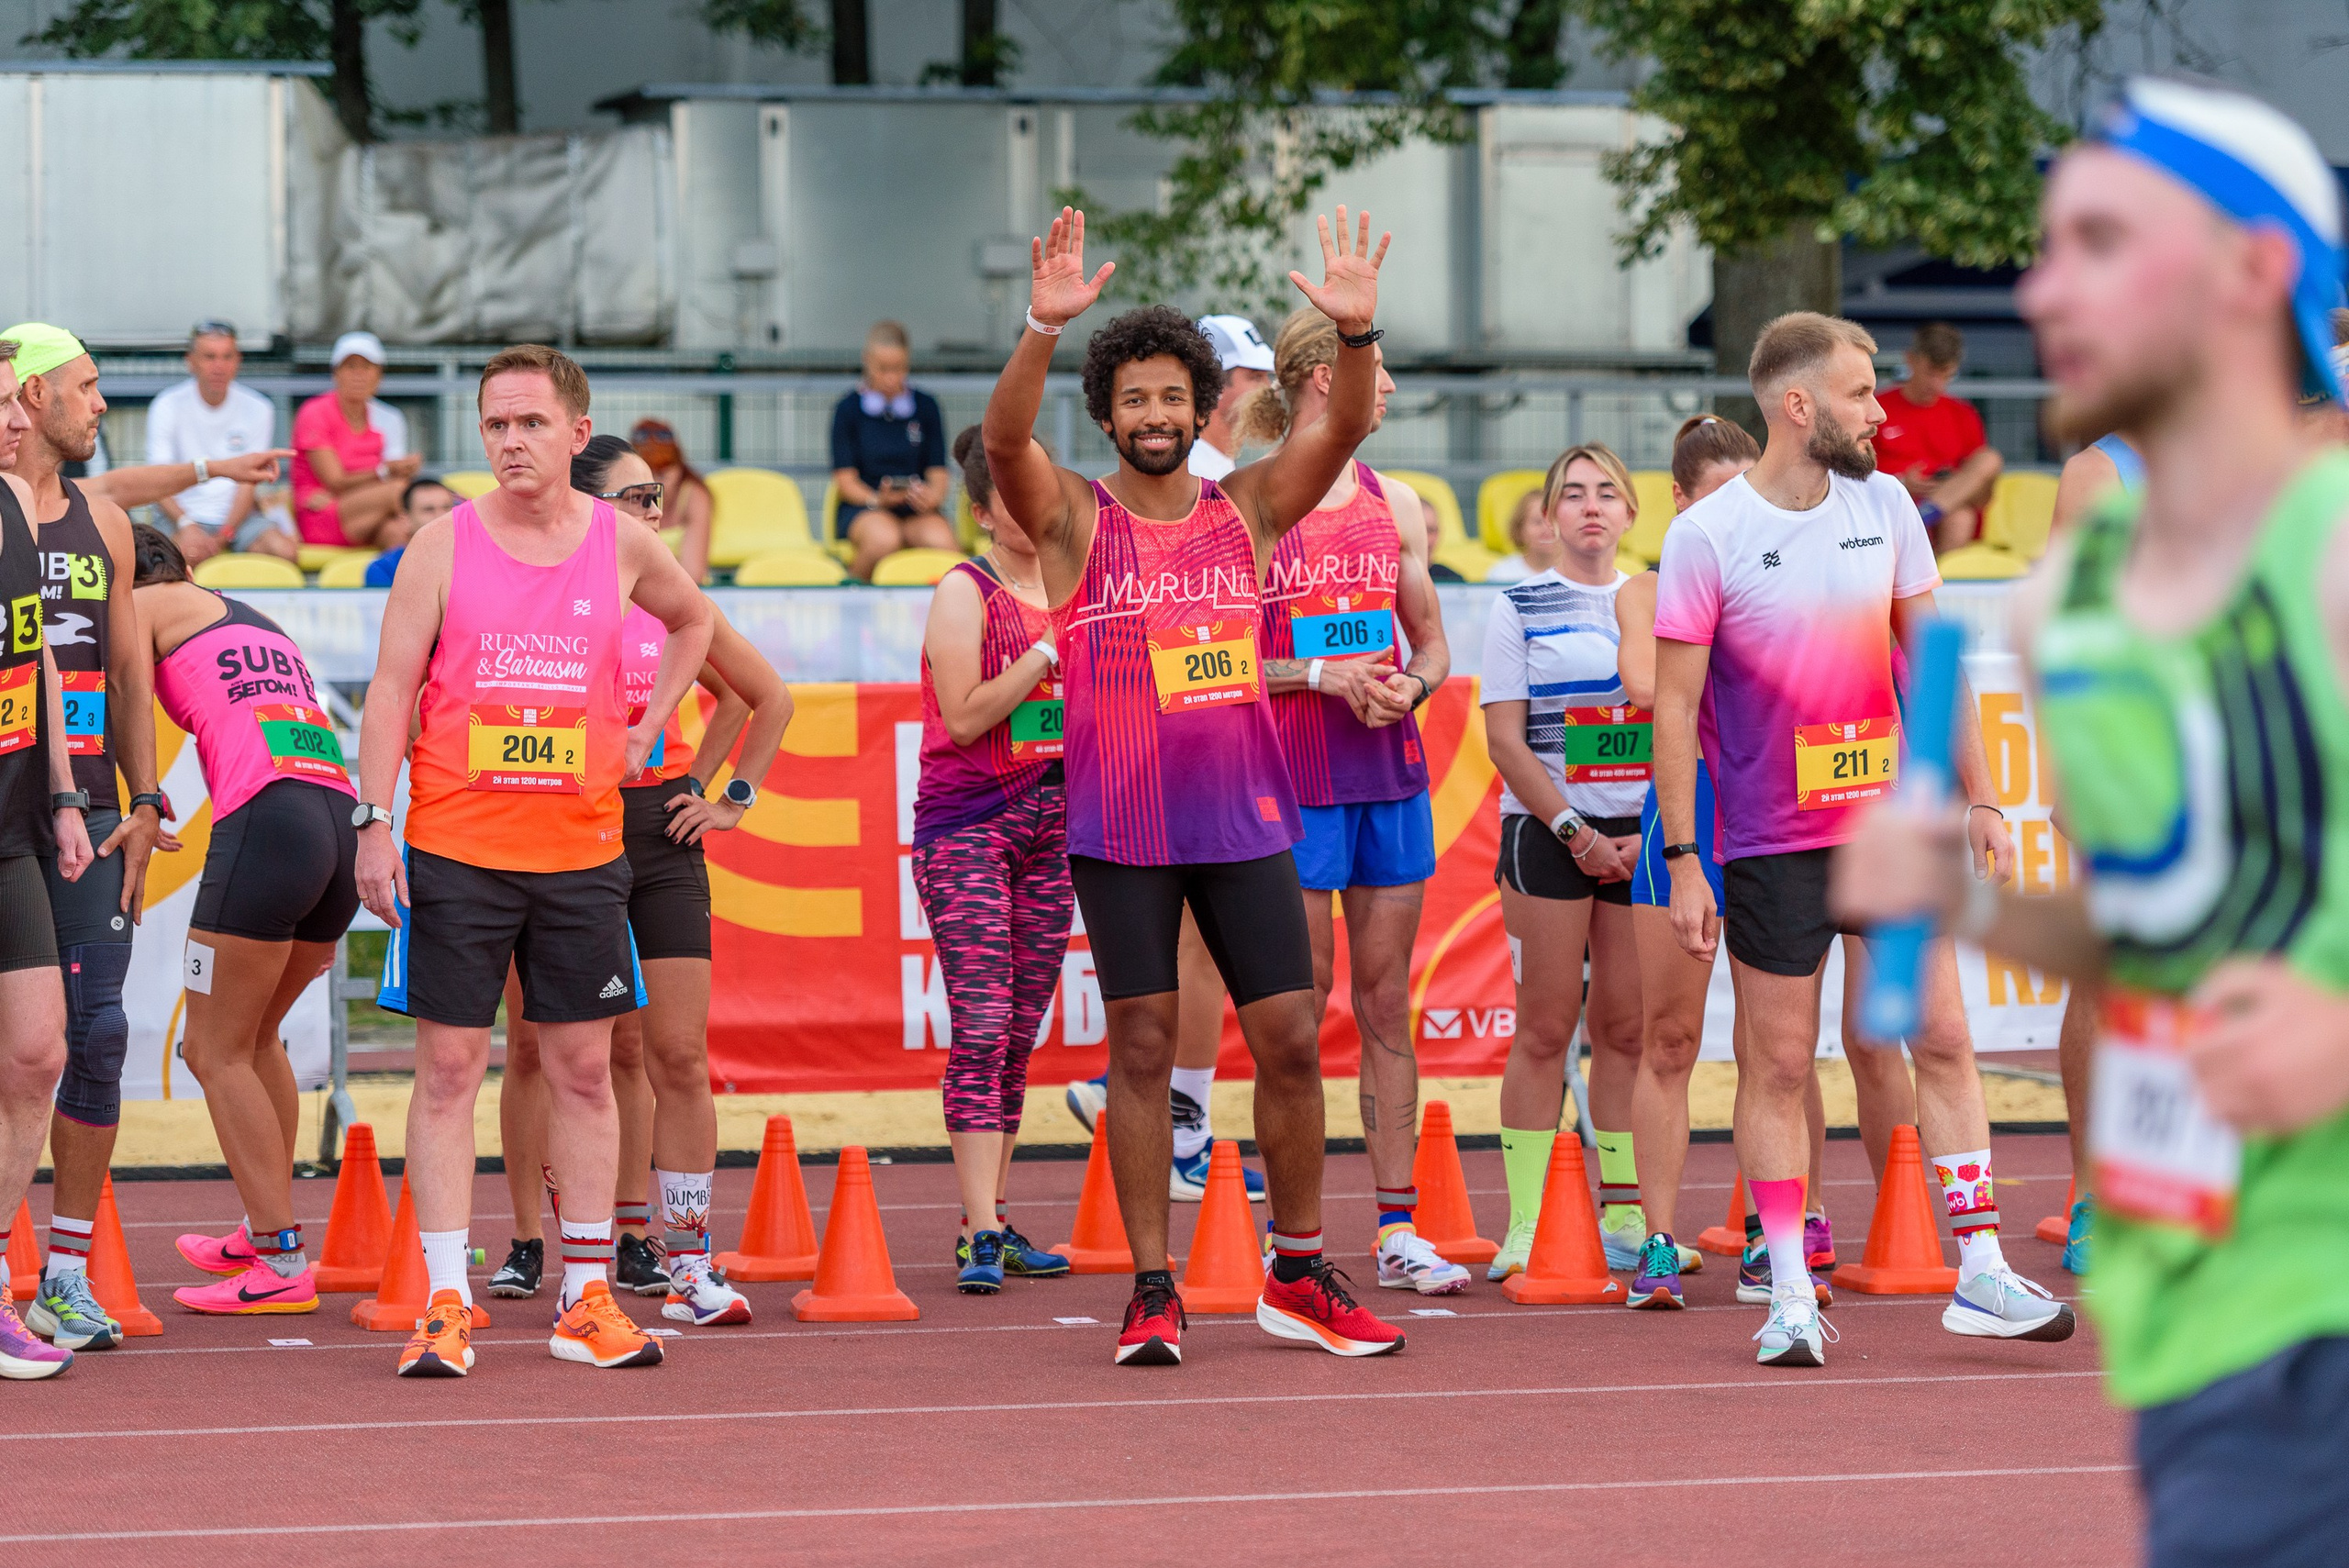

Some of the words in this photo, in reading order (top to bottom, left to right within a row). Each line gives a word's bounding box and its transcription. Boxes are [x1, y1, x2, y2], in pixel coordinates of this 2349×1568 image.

[1838, 536, 1884, 550] wbteam
[479, 632, 589, 655] RUNNING
[1324, 619, 1369, 649] 206
[1377, 629, 1385, 644] 3
[217, 645, 293, 681] SUB
[495, 648, 588, 680] Sarcasm
[1185, 650, 1233, 682] 206
[1241, 660, 1249, 675] 2
[1193, 694, 1208, 703] этап
[1208, 691, 1222, 701] 1200
[1222, 689, 1243, 699] метров
[21, 705, 28, 721] 2
[87, 712, 95, 728] 3
[1040, 706, 1063, 733] 20
[289, 728, 328, 755] 202
[503, 734, 555, 764] 204
[565, 750, 574, 765] 2
[1598, 730, 1640, 758] 207
[1833, 749, 1869, 780] 211
[1882, 758, 1890, 773] 2
[493, 775, 502, 784] 2й
[503, 776, 519, 784] этап
[520, 776, 537, 785] 1200
[538, 777, 562, 787] метров
[1831, 792, 1845, 802] этап
[1845, 790, 1860, 800] 1200
[1860, 788, 1881, 798] метров
[191, 959, 202, 976] 3
[599, 986, 629, 999] adidas
[1948, 1195, 1965, 1209] wb
